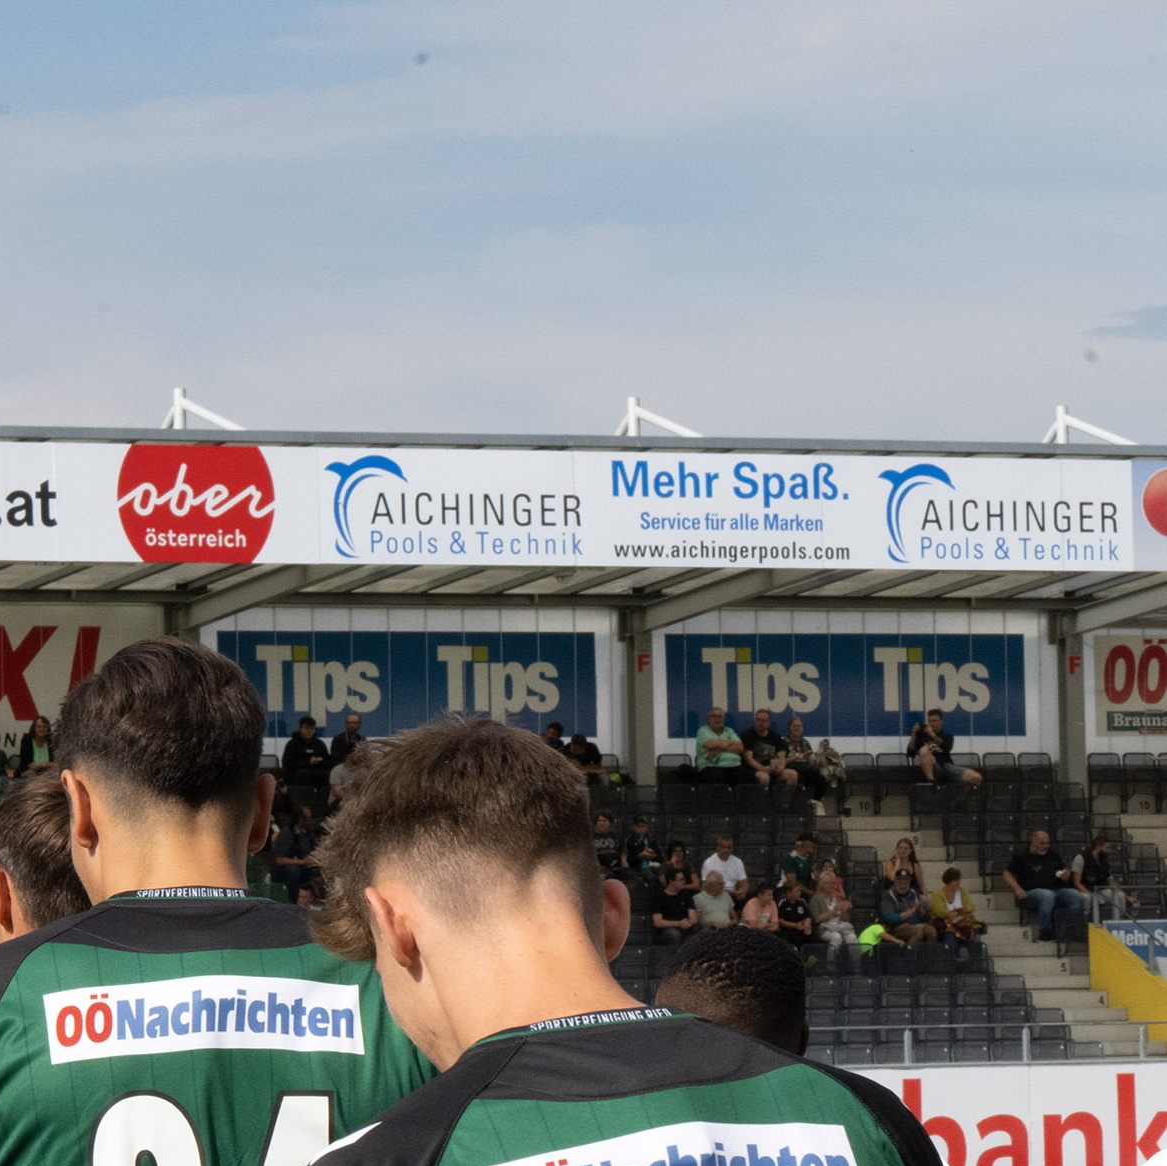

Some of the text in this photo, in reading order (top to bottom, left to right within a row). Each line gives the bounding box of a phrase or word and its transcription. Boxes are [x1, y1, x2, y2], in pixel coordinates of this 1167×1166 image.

[117, 463, 275, 518] ober
[611, 460, 850, 508] Mehr Spaß.
[370, 491, 582, 527] AICHINGER
[640, 511, 824, 533] Service für alle Marken
[921, 499, 1119, 535] AICHINGER
[144, 528, 247, 549] österreich
[370, 530, 584, 557] Pools & Technik
[614, 541, 851, 564] www.aichingerpools.com
[921, 537, 1120, 562] Pools & Technik
[256, 645, 381, 728] Tips
[437, 645, 561, 724] Tips
[701, 646, 822, 713] Tips
[874, 646, 992, 713] Tips
[55, 989, 355, 1048] OÖNachrichten
